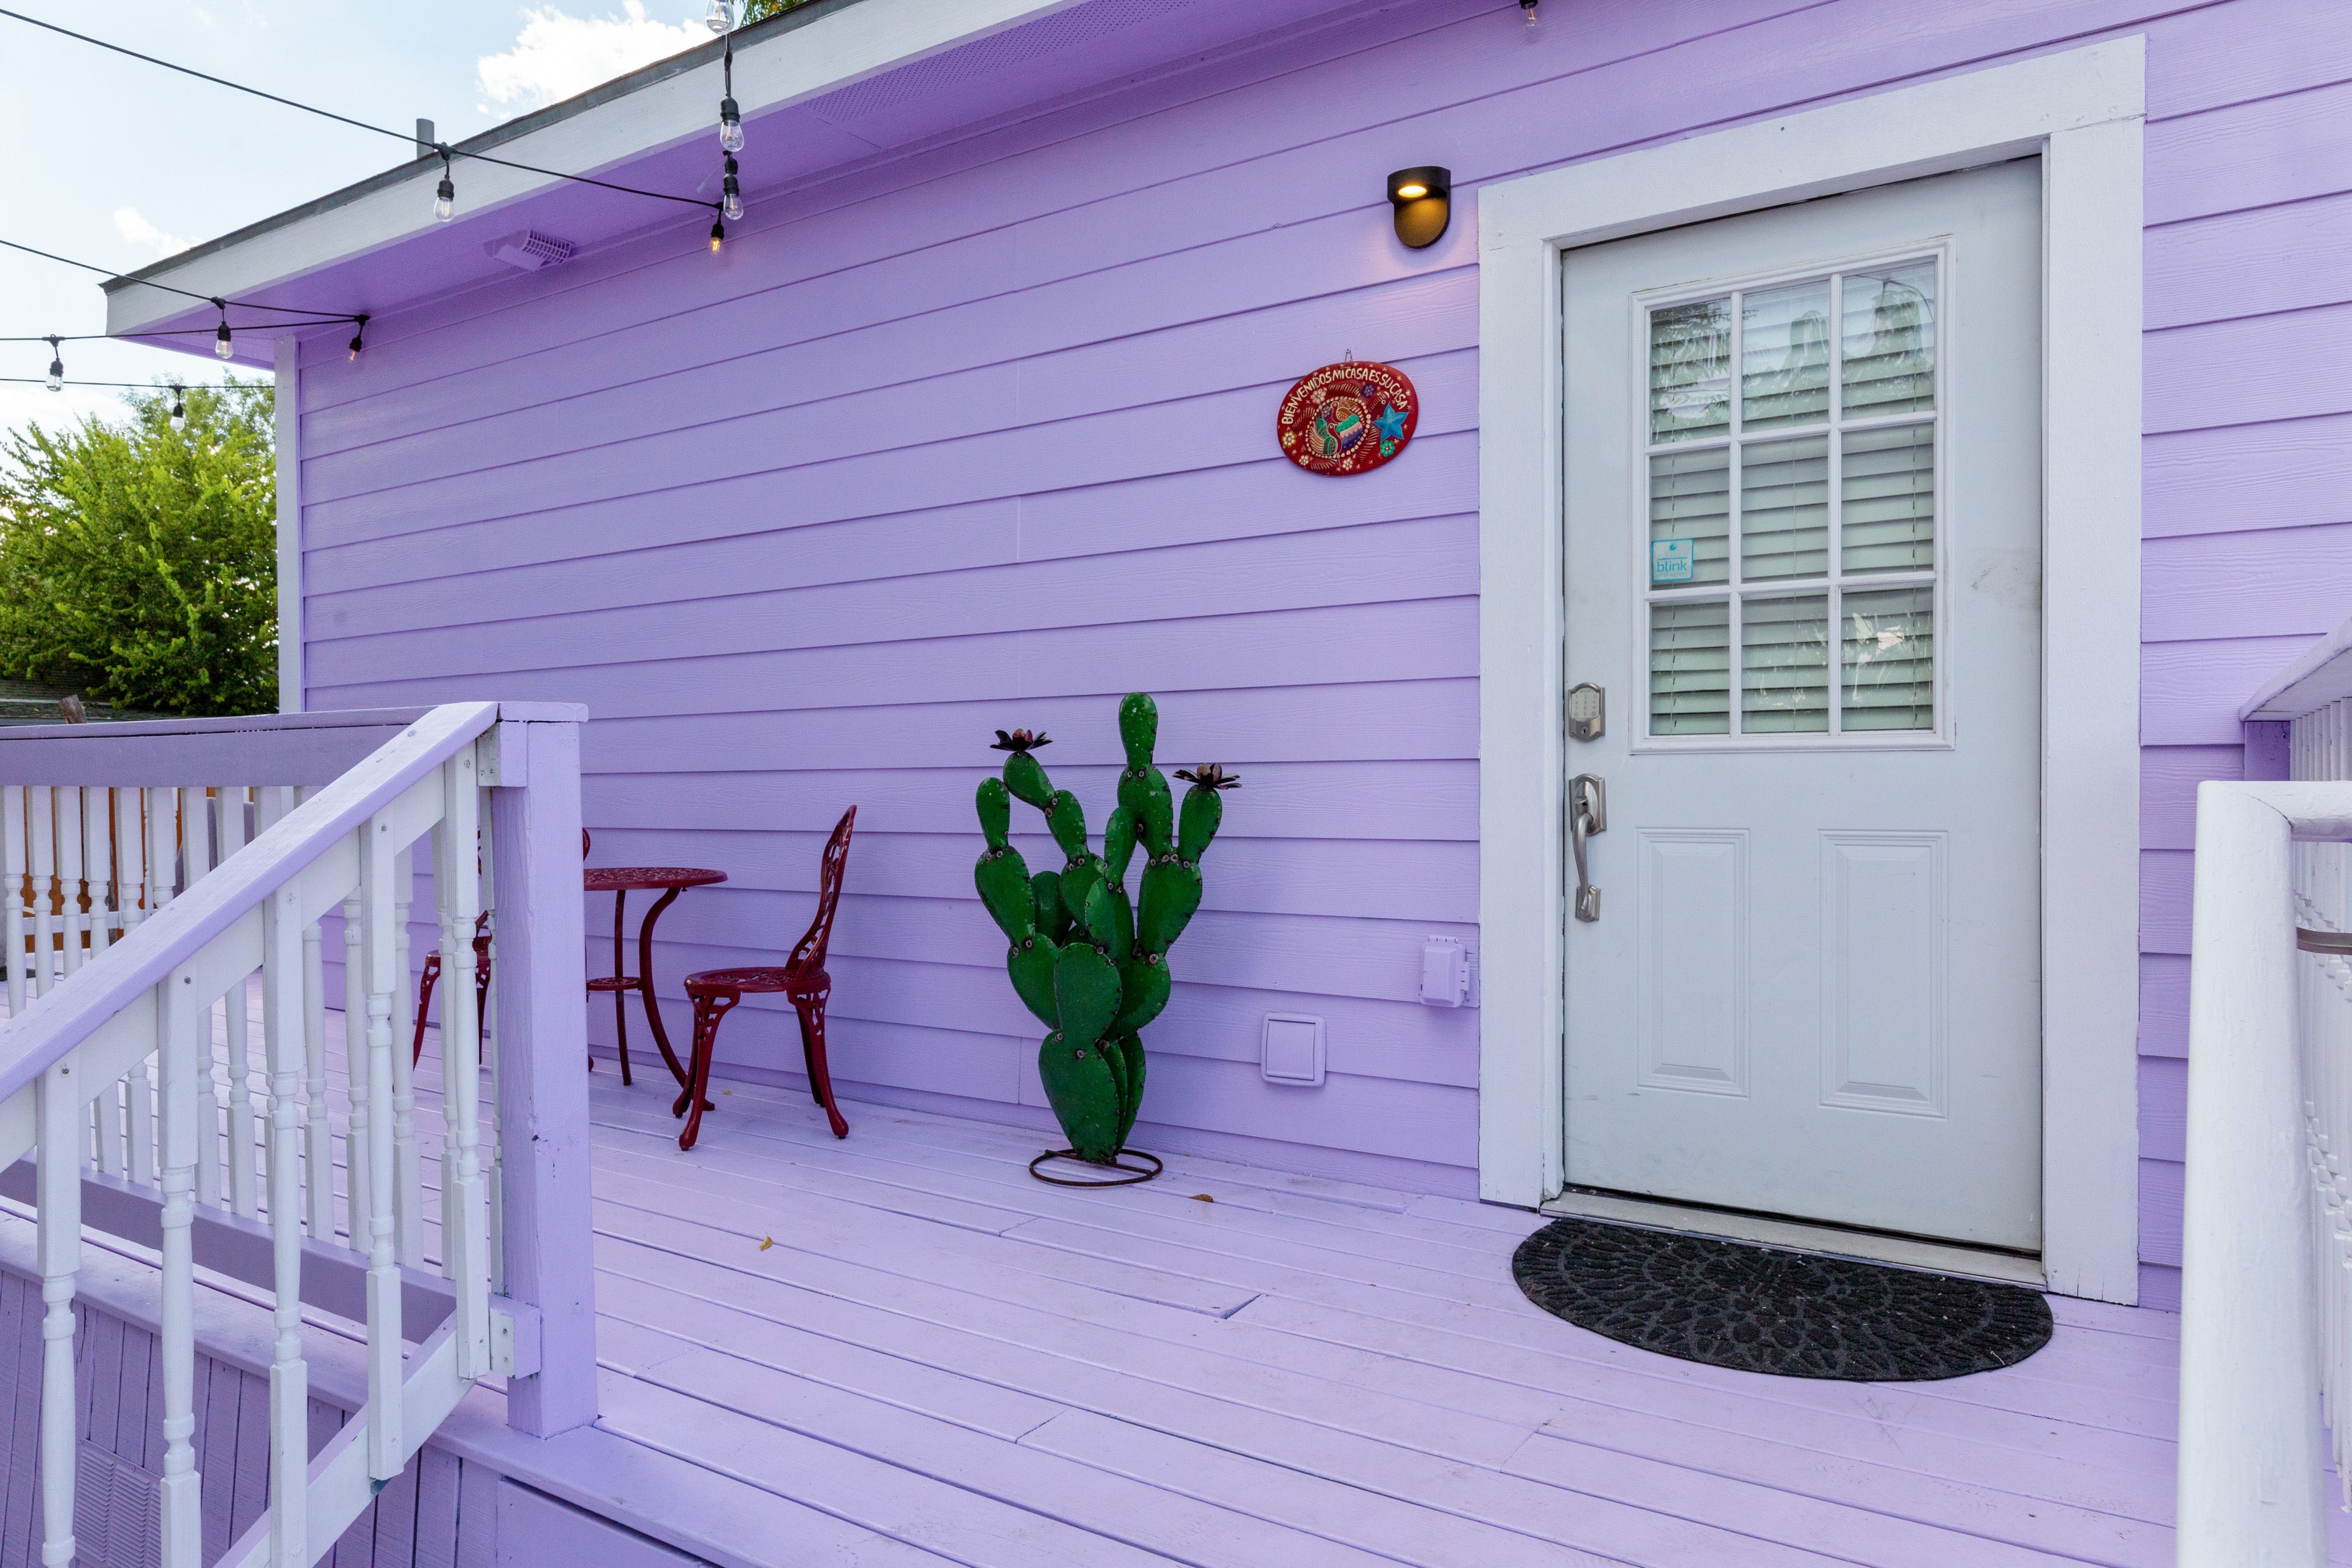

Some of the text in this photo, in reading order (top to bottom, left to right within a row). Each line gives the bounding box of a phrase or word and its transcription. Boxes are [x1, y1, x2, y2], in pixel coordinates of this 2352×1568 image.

[1281, 368, 1408, 424] BIENVENIDOS MI CASA ES SU CASA
[1657, 560, 1687, 572] blink
